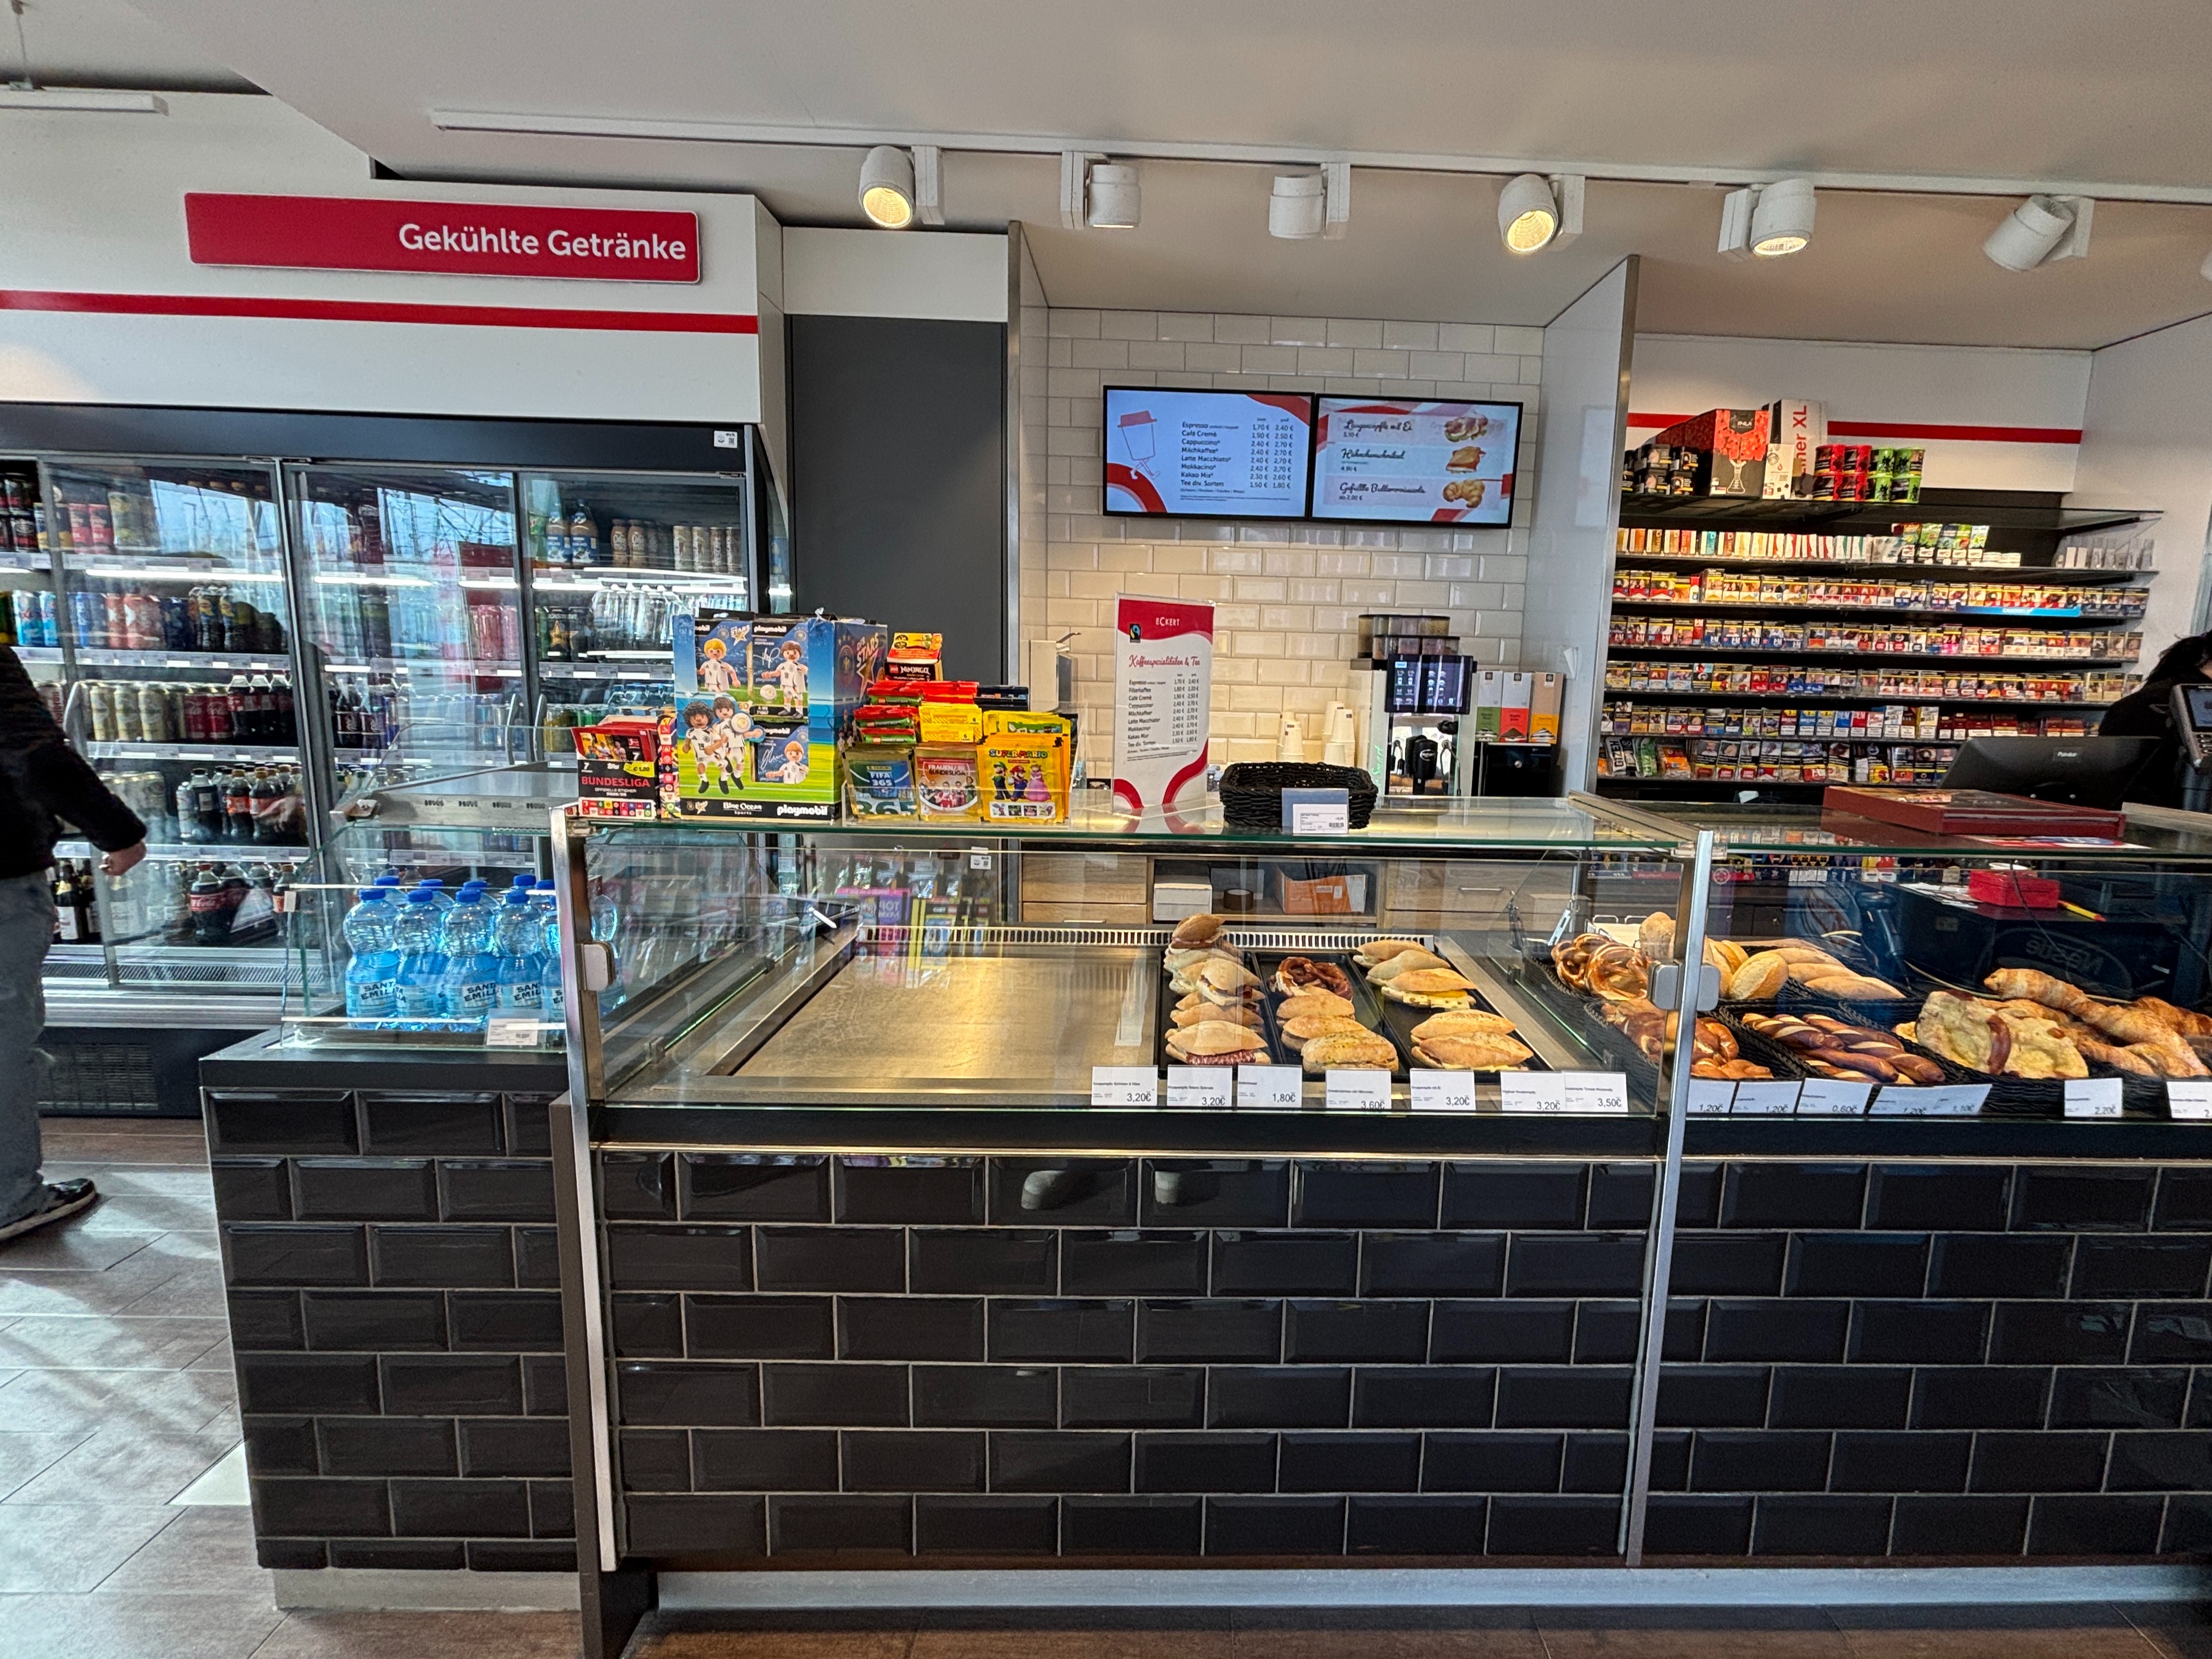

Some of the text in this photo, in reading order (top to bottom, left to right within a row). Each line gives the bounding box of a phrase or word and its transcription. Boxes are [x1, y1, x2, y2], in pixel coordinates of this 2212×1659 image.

[399, 223, 687, 260] Gekühlte Getränke
[1793, 405, 1807, 429] XL
[1156, 617, 1180, 627] ECKERT
[754, 625, 787, 633] playmobil
[856, 632, 879, 668] STARS
[1190, 656, 1200, 666] Tee
[633, 752, 640, 760] 7
[989, 749, 1048, 759] SUPER MARIO
[581, 777, 650, 787] BUNDESLIGA
[777, 805, 828, 816] playmobil
[1127, 1093, 1151, 1102] 3,20€
[1202, 1097, 1226, 1105] 3,20€
[1273, 1093, 1296, 1103] 1,80€
[1446, 1097, 1470, 1106] 3,20€
[1597, 1098, 1622, 1107] 3,50€
[1537, 1101, 1561, 1111] 3,20€
